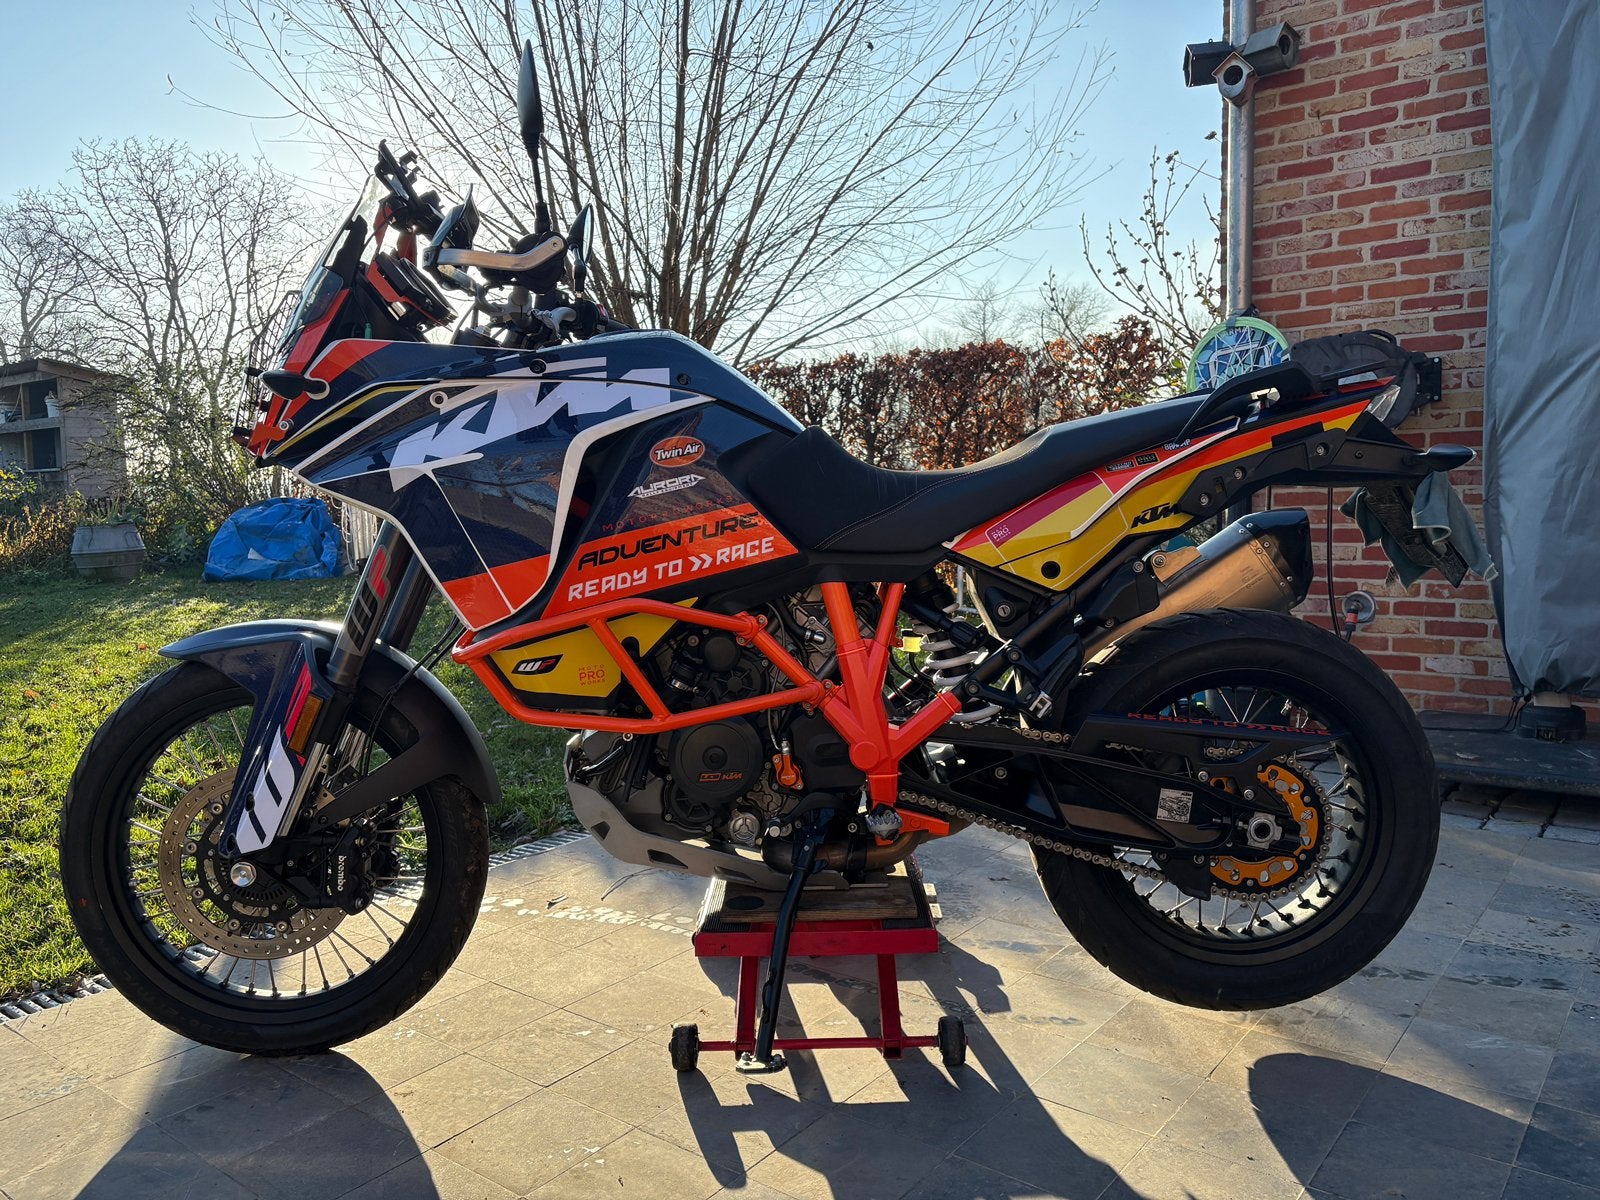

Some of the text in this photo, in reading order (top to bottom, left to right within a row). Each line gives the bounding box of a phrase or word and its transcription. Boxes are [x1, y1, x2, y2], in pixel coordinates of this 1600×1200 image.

[389, 357, 670, 492] KTM
[655, 443, 702, 461] Twin Air
[627, 474, 706, 497] AURORA
[1131, 503, 1180, 528] KTM
[578, 512, 759, 571] ADVENTURE
[568, 536, 775, 602] READY TO RACE
[517, 659, 556, 672] WP
[578, 664, 605, 672] MOTO
[578, 669, 605, 681] PRO
[1128, 712, 1332, 736] READY TO RACE
[721, 771, 742, 781] KTM
[337, 855, 347, 891] brembo
